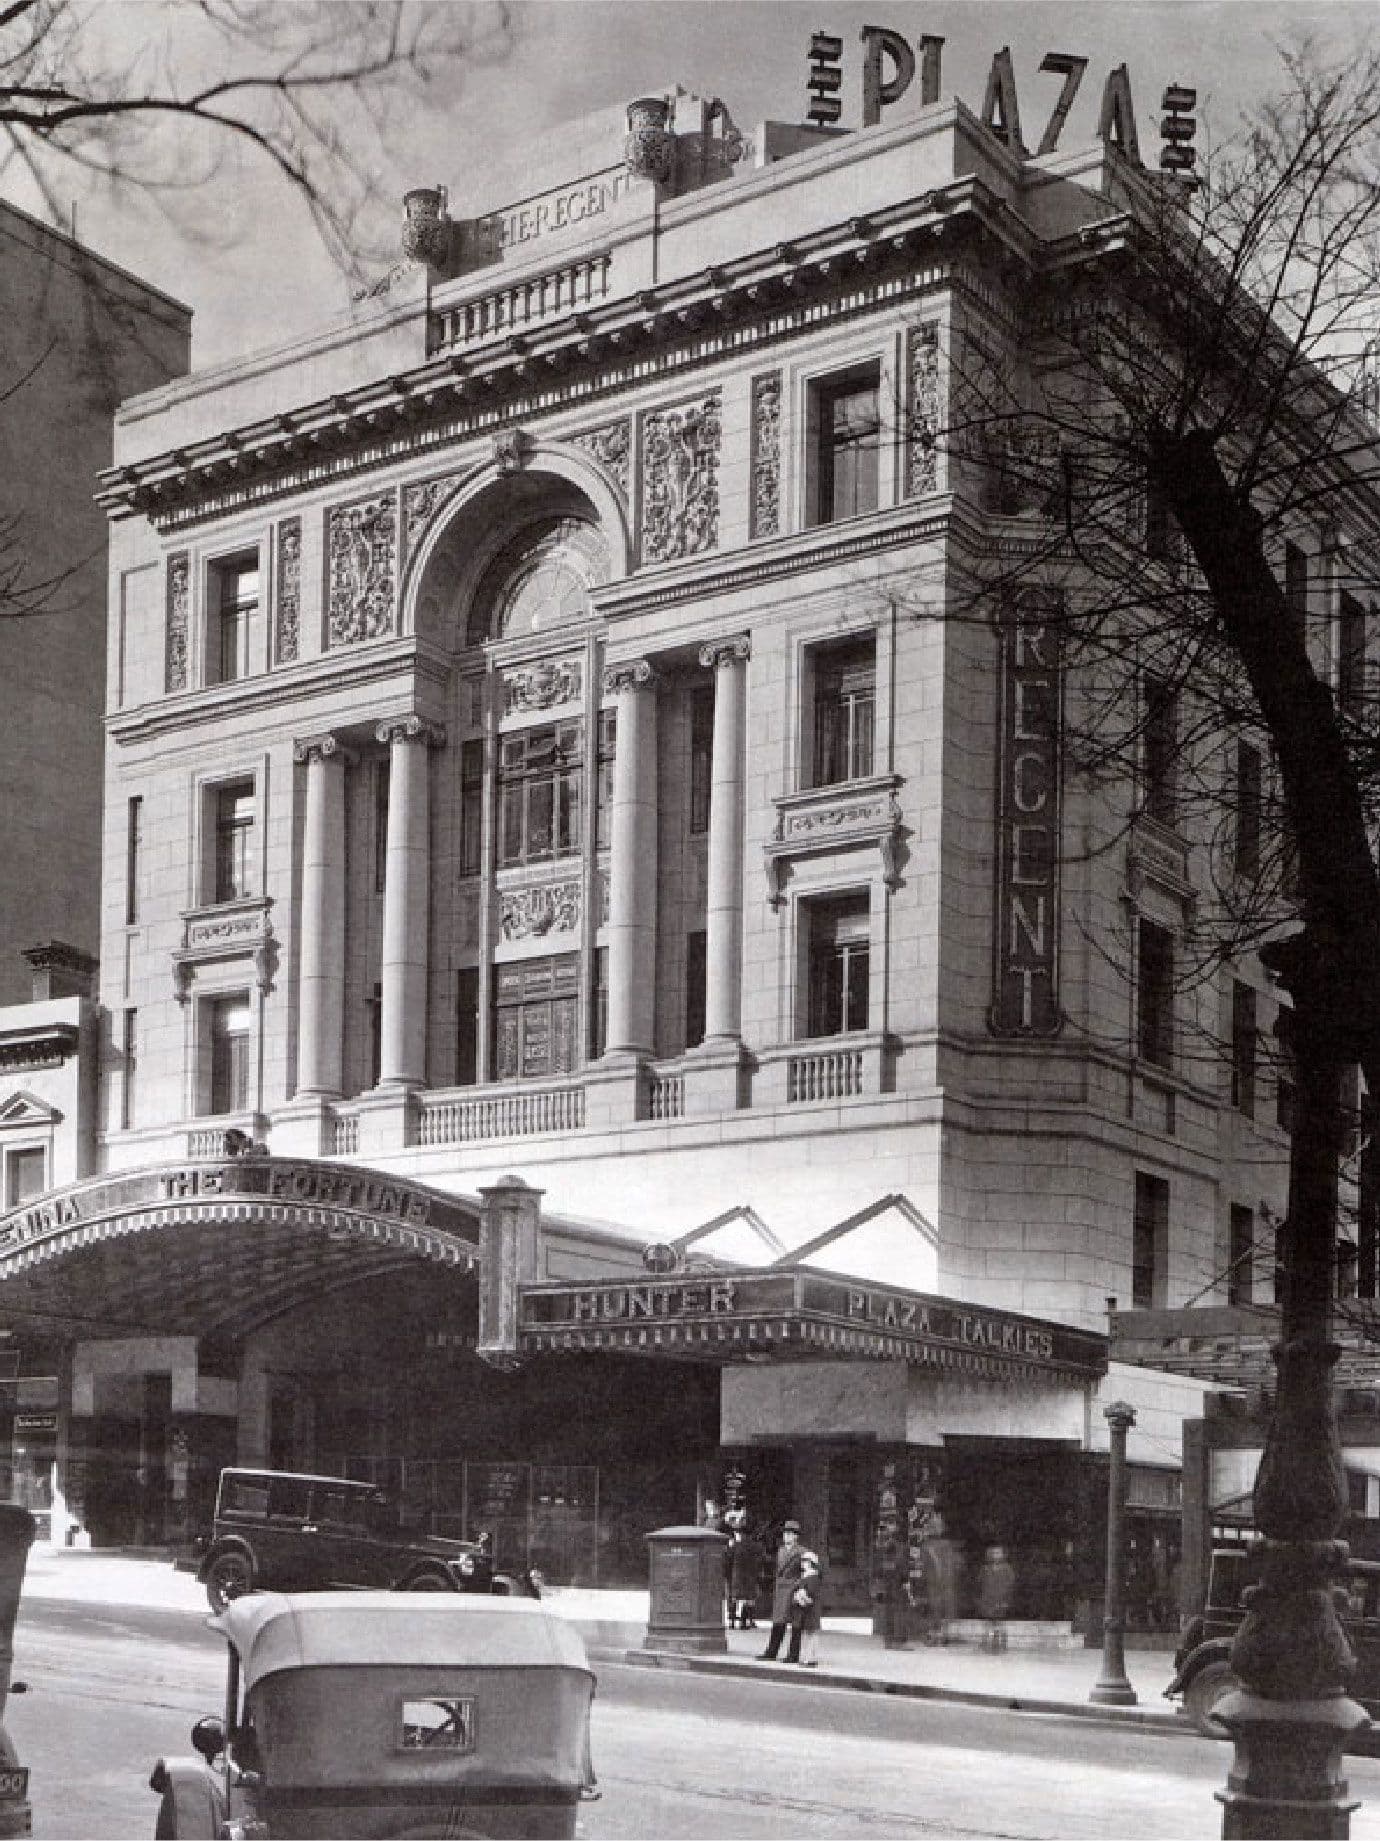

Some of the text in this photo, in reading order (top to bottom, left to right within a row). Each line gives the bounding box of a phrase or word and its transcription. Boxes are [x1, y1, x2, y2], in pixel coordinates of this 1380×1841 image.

[860, 25, 1146, 171] PLAZA
[1008, 607, 1049, 1028] REGENT
[160, 1170, 223, 1198] THE
[575, 1284, 735, 1318] HUNTER
[848, 1290, 1054, 1360] PLAZA TALKIES
